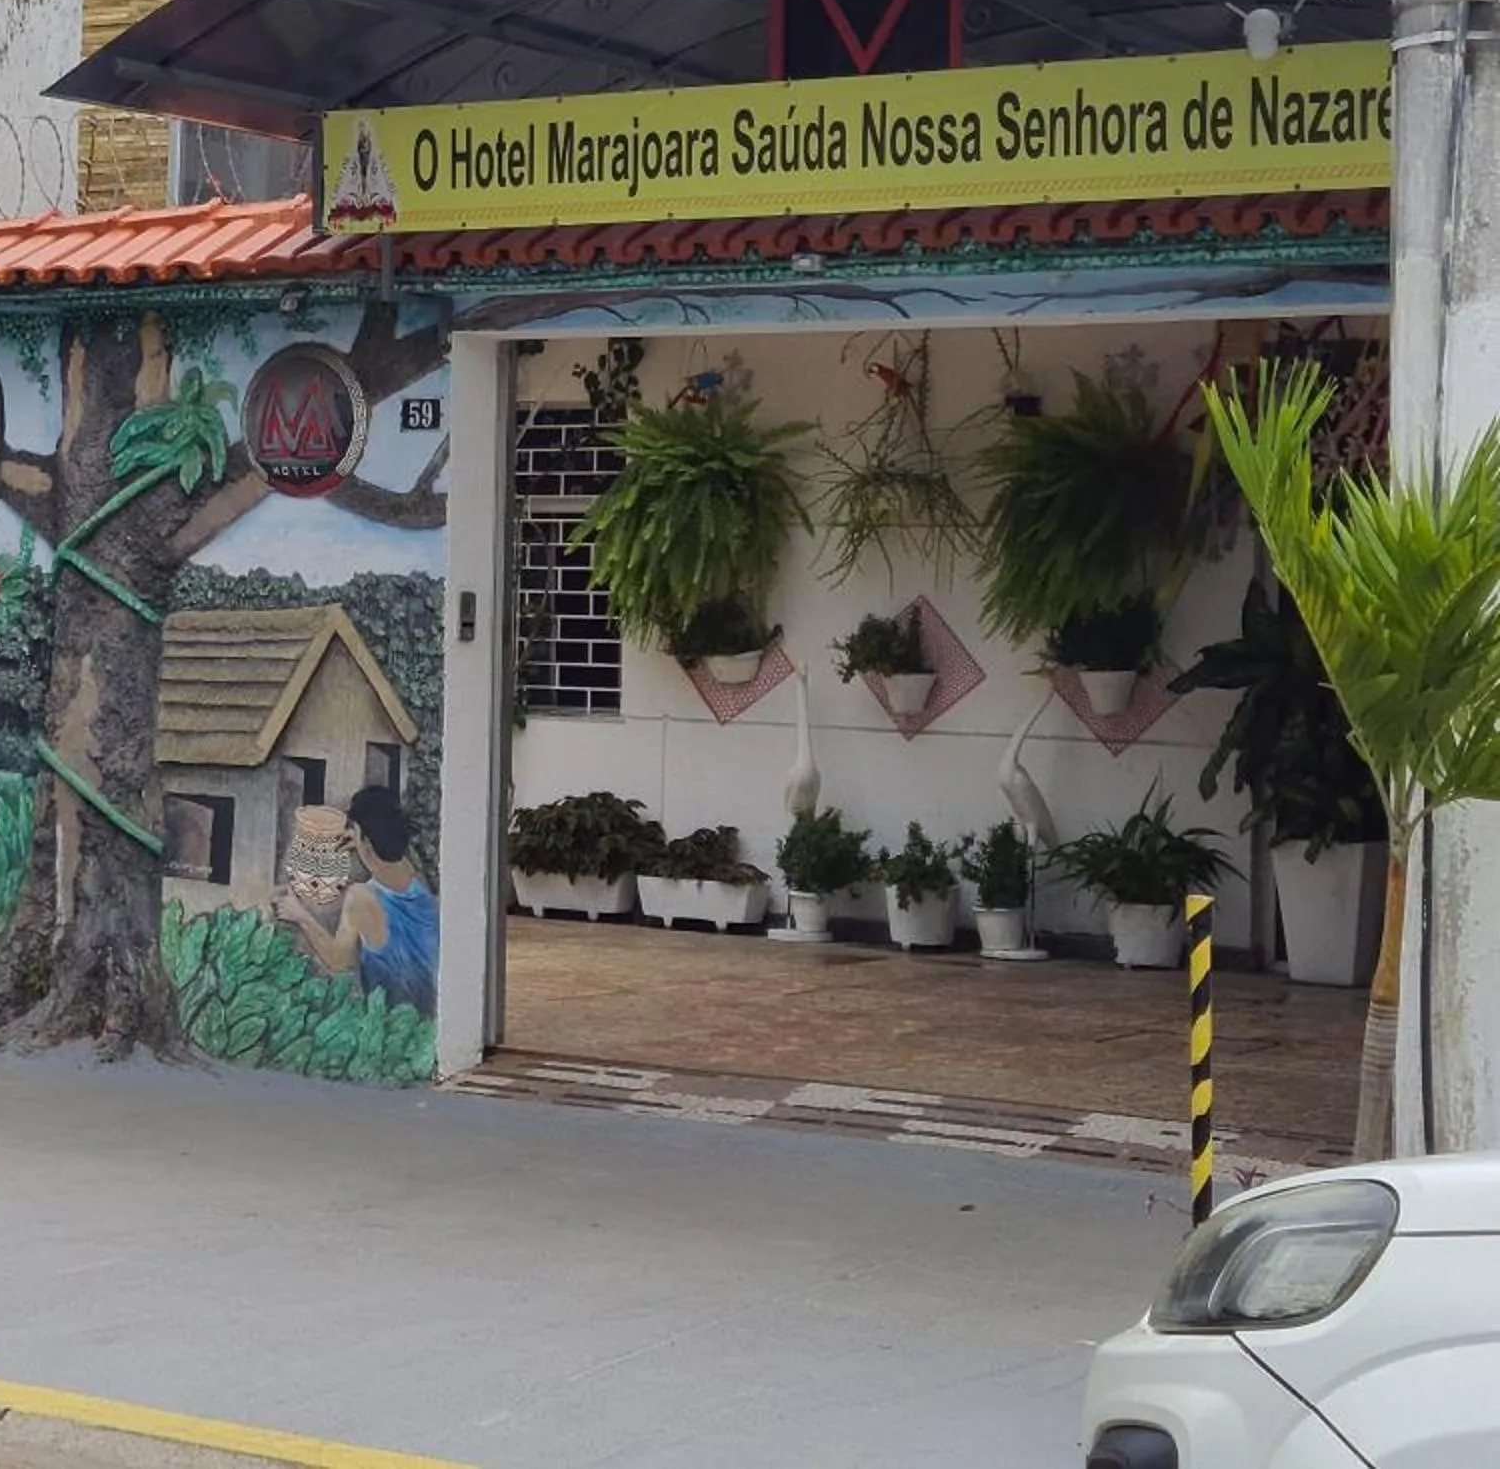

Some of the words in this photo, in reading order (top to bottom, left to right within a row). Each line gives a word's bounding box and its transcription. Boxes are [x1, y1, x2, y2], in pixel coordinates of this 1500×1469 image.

[413, 128, 440, 193] O
[450, 123, 535, 191] Hotel
[547, 116, 719, 198] Marajoara
[731, 104, 848, 176] Saúda
[860, 101, 982, 168] Nossa
[995, 87, 1167, 162] Senhora
[1182, 80, 1234, 151] de
[408, 400, 433, 428] 59
